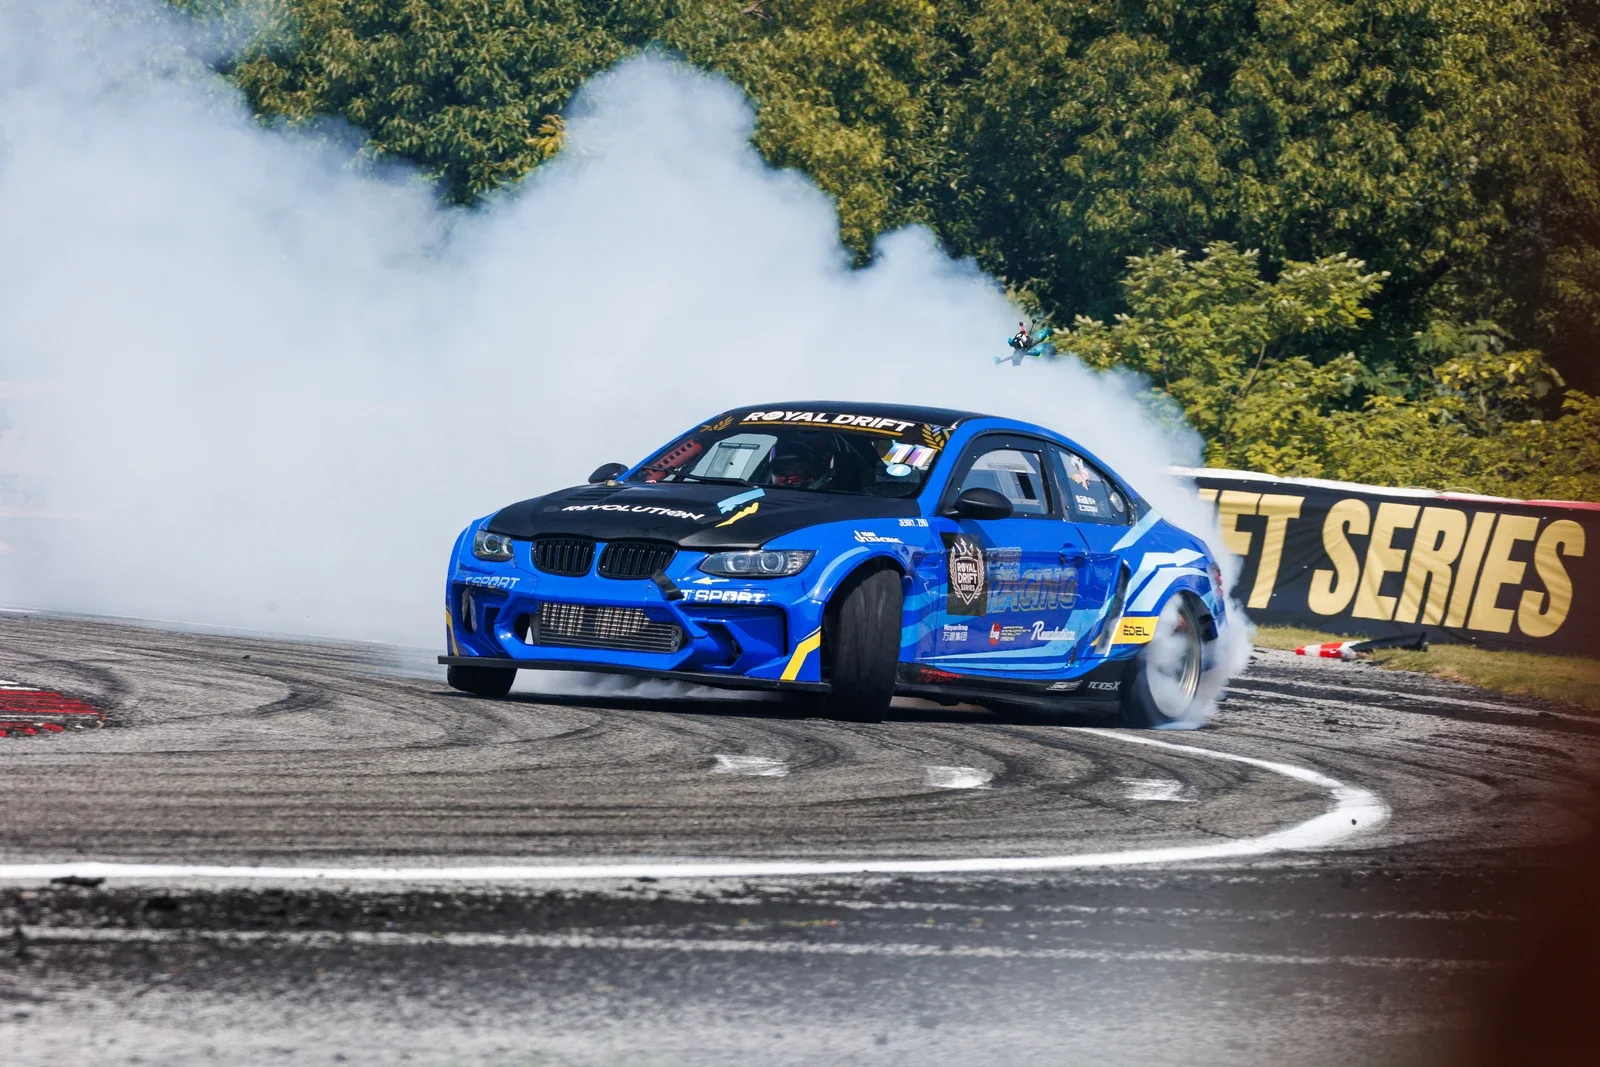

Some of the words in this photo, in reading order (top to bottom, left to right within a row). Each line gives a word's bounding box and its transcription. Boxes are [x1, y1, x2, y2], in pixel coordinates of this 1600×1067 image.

[743, 411, 829, 423] ROYAL
[832, 413, 915, 432] DRIFT
[561, 504, 705, 521] REVOLUTION
[957, 562, 977, 573] ROYAL
[1198, 488, 1305, 609] FT
[1307, 499, 1586, 638] SERIES
[957, 572, 978, 584] DRIFT
